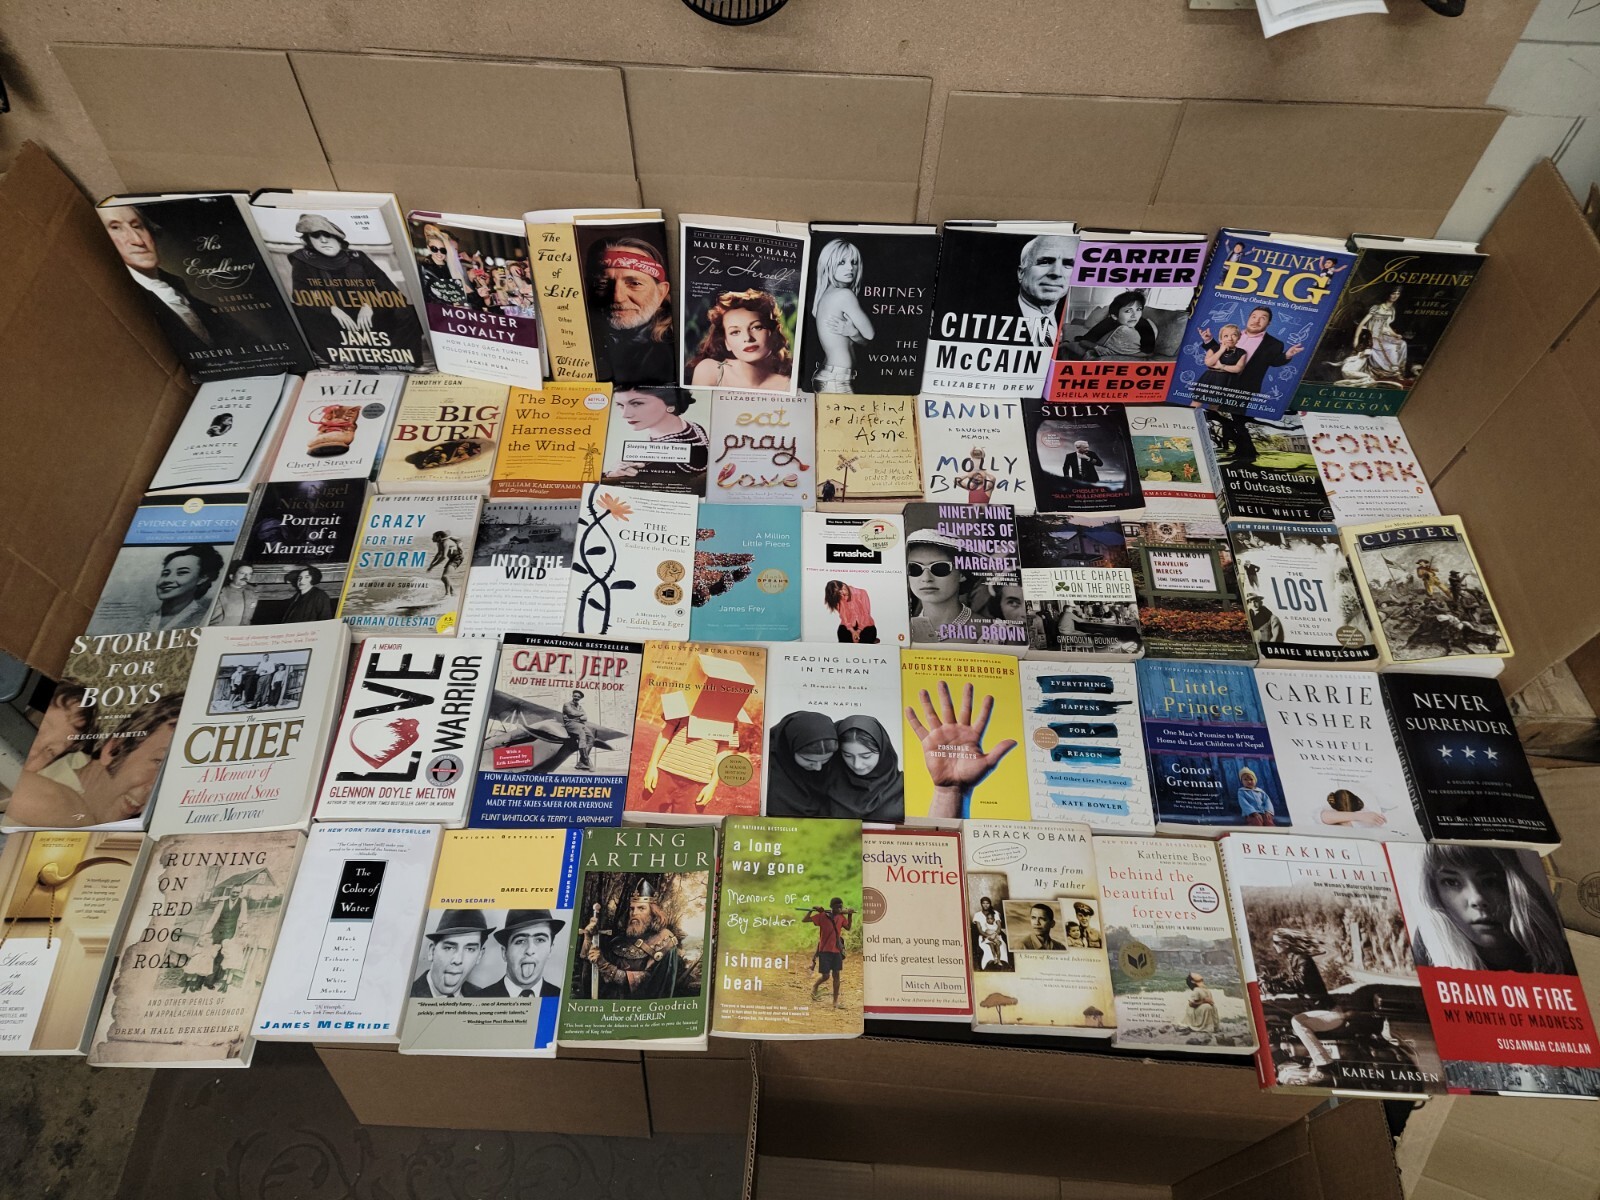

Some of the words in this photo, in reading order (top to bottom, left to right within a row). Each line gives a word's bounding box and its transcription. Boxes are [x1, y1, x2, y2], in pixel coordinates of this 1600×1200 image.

[197, 234, 221, 251] His
[693, 240, 749, 252] MAUREEN
[755, 246, 797, 259] O'HARA
[537, 249, 572, 262] Facts
[1082, 247, 1202, 264] CARRIE
[1252, 247, 1320, 272] THINK
[183, 258, 255, 289] Excellency
[1077, 267, 1196, 284] FISHER
[1215, 260, 1331, 306] BIG
[294, 289, 338, 307] JOHN
[341, 291, 407, 308] LENNON
[544, 284, 579, 299] Life
[864, 286, 926, 299] BRITNEY
[872, 304, 923, 315] SPEARS
[442, 307, 517, 328] MONSTER
[448, 322, 516, 342] LOYALTY
[941, 312, 1051, 343] CITIZEN
[341, 331, 391, 346] JAMES
[327, 348, 415, 363] PATTERSON
[555, 355, 590, 367] Willie
[936, 345, 1042, 374] McCAIN
[557, 367, 593, 379] Nelson
[320, 379, 379, 397] wild
[932, 380, 996, 391] ELIZABETH
[1002, 383, 1034, 391] DREW
[517, 393, 546, 405] The
[550, 394, 579, 408] Boy
[1319, 388, 1386, 400] CAROLLY
[924, 399, 1018, 419] BANDIT
[1040, 404, 1111, 418] SULLY
[1300, 397, 1392, 413] ERICKSON
[435, 405, 500, 422] BIG
[515, 409, 550, 420] Who
[394, 422, 498, 442] BURN
[511, 424, 591, 436] Harnessed
[508, 441, 530, 452] the
[535, 440, 576, 452] Wind
[286, 459, 320, 469] Cheryl
[321, 458, 363, 466] Strayed
[1226, 468, 1236, 478] In
[1239, 469, 1258, 479] the
[1260, 471, 1316, 484] Sanctuary
[1230, 481, 1241, 491] of
[1244, 482, 1292, 495] Outcasts
[939, 506, 1013, 520] NINETY-NINE
[1238, 505, 1267, 516] NEIL
[1273, 508, 1310, 518] WHITE
[280, 514, 341, 526] Portrait
[370, 514, 426, 529] CRAZY
[644, 522, 668, 532] THE
[308, 528, 325, 540] of
[327, 531, 337, 539] a
[937, 522, 996, 537] GLIMPSES
[999, 524, 1014, 537] OF
[1361, 525, 1455, 546] CUSTER
[618, 529, 691, 547] CHOICE
[261, 542, 334, 555] Marriage
[833, 550, 874, 558] smashed
[957, 540, 1016, 554] PRINCESS
[359, 551, 426, 568] STORM
[490, 554, 533, 568] INTO
[535, 554, 563, 568] THE
[954, 556, 1018, 571] MARGARET
[505, 567, 547, 580] WILD
[1053, 570, 1086, 580] LITTLE
[1092, 571, 1130, 581] CHAPEL
[1071, 582, 1083, 593] ON
[1085, 583, 1103, 593] THE
[1106, 583, 1131, 594] RIVER
[1271, 577, 1329, 613] LOST
[718, 605, 746, 613] James
[748, 605, 766, 613] Frey
[939, 623, 978, 640] CRAIG
[982, 626, 1026, 642] BROWN
[70, 627, 202, 655] STORIES
[784, 655, 839, 665] READING
[845, 657, 887, 665] LOLITA
[1267, 647, 1302, 656] DANIEL
[1305, 649, 1370, 658] MENDELSOHN
[106, 661, 155, 678] FOR
[512, 650, 575, 675] CAPT.
[579, 655, 628, 678] JEPP
[820, 667, 870, 675] TEHRAN
[901, 663, 952, 673] AUGUSTEN
[957, 664, 1015, 675] BURROUGHS
[1051, 680, 1107, 689] EVERYTHING
[1169, 678, 1228, 696] Little
[78, 683, 164, 708] BOYS
[1265, 682, 1373, 706] CARRIE
[432, 655, 482, 753] WARRIOR
[1164, 697, 1244, 716] Princes
[1412, 693, 1491, 713] NEVER
[1278, 710, 1372, 730] FISHER
[1406, 717, 1513, 736] SURRENDER
[67, 733, 110, 741] GREGORY
[112, 730, 148, 739] MARTIN
[184, 720, 304, 765] CHIEF
[1171, 763, 1211, 775] Conor
[1166, 777, 1223, 789] Grennan
[329, 787, 375, 798] GLENNON
[379, 787, 411, 798] DOYLE
[416, 788, 456, 799] MELTON
[491, 784, 532, 797] ELREY
[535, 786, 547, 797] B.
[550, 785, 612, 799] JEPPESEN
[615, 833, 686, 847] KING
[973, 830, 1031, 840] BARACK
[1037, 833, 1087, 843] OBAMA
[733, 842, 741, 851] a
[749, 838, 782, 854] long
[1241, 843, 1351, 861] BREAKING
[166, 852, 267, 867] RUNNING
[586, 852, 709, 867] ARTHUR
[355, 868, 371, 877] The
[732, 861, 760, 874] way
[768, 861, 805, 876] gone
[886, 865, 959, 885] Morrie
[1109, 867, 1163, 882] behind
[1169, 869, 1194, 883] the
[159, 877, 188, 892] ON
[342, 883, 367, 894] Color
[368, 884, 379, 896] of
[1103, 886, 1175, 901] beautiful
[149, 902, 193, 917] RED
[340, 902, 370, 913] Water
[1133, 906, 1197, 920] forevers
[142, 928, 183, 943] DOG
[133, 954, 189, 970] ROAD
[725, 952, 789, 969] ishmael
[723, 975, 763, 991] beah
[905, 980, 931, 989] Mitch
[934, 982, 962, 990] Albom
[1436, 980, 1498, 1008] BRAIN
[1501, 985, 1530, 1009] ON
[1533, 988, 1577, 1013] FIRE
[260, 1020, 310, 1030] JAMES
[1496, 1038, 1547, 1053] SUSANNAH
[1549, 1041, 1592, 1055] CAHALAN
[1341, 1066, 1386, 1080] KAREN
[1390, 1069, 1440, 1083] LARSEN
